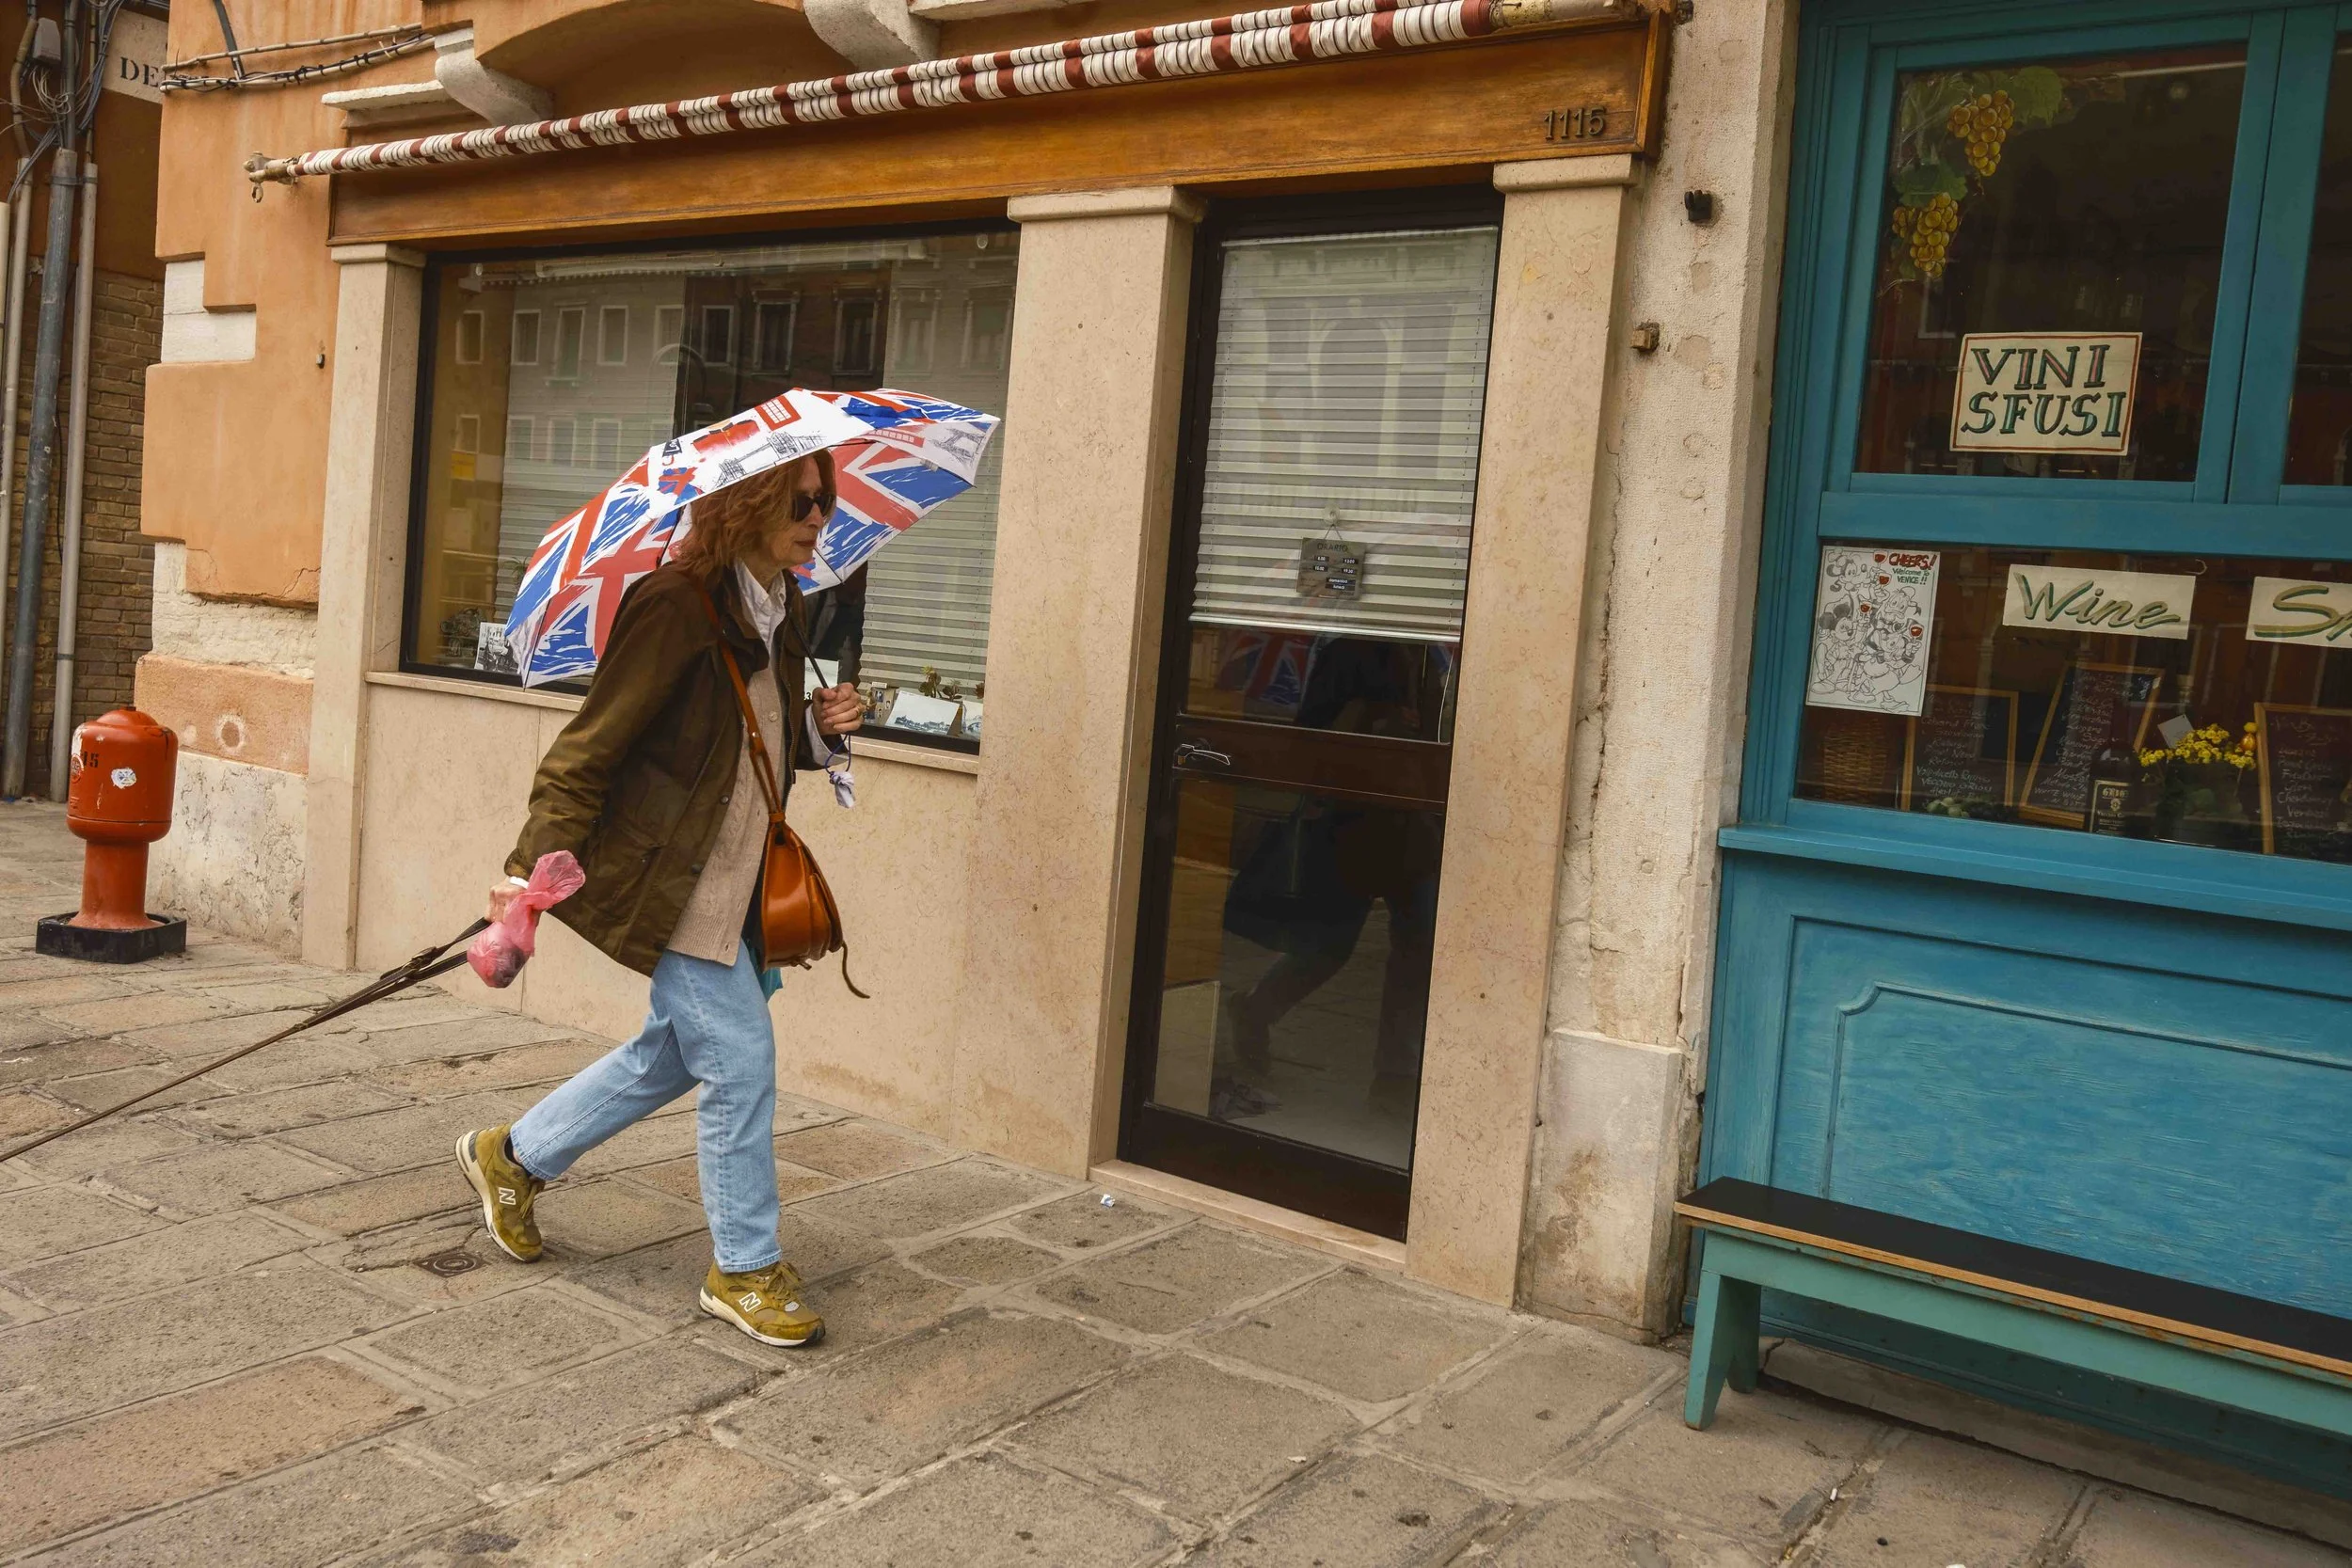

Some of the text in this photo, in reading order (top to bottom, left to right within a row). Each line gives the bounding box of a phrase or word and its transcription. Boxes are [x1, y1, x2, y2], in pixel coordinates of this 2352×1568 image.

[1544, 106, 1606, 140] 1115
[1971, 344, 2110, 389] VINI
[1961, 390, 2126, 437] SFUSI
[1317, 542, 1348, 552] ORARIO
[1889, 552, 1938, 570] CHEERS!
[2013, 572, 2180, 628] Wine
[498, 1186, 516, 1206] N
[739, 1291, 762, 1312] N
